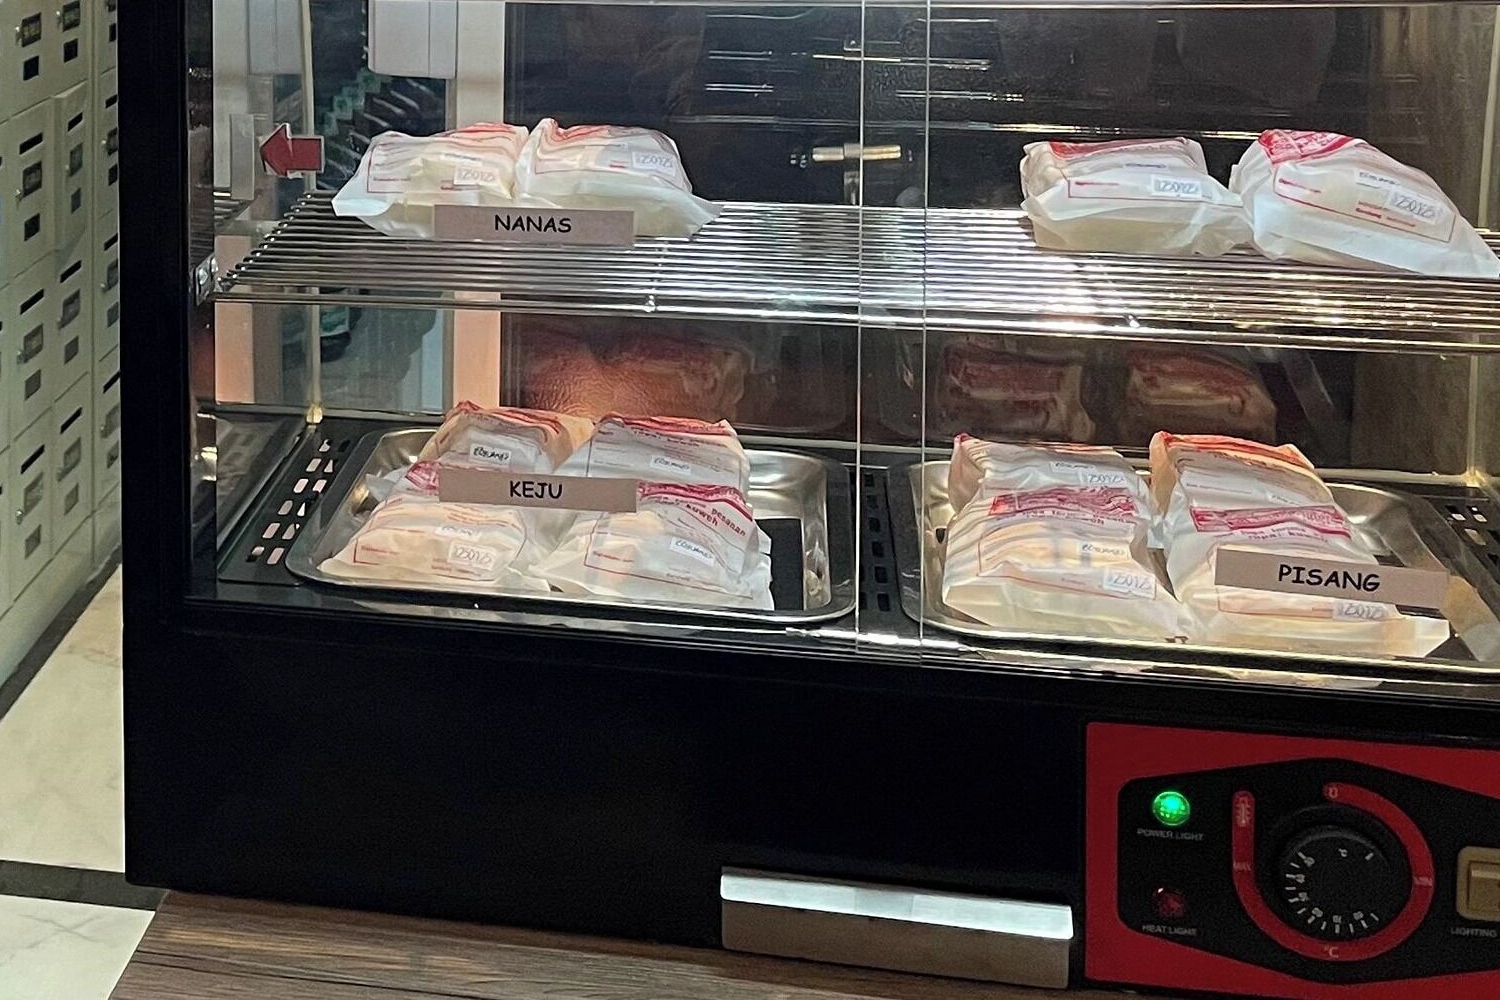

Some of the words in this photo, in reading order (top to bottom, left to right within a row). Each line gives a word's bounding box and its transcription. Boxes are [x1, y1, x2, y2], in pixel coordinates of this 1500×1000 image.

[494, 214, 573, 234] NANAS
[509, 480, 564, 499] KEJU
[1278, 564, 1381, 592] PISANG
[1137, 828, 1173, 839] POWER
[1175, 832, 1204, 841] LIGHT
[1142, 924, 1167, 933] HEAT
[1168, 927, 1197, 936] LIGHT
[1449, 927, 1498, 938] LIGHTING
